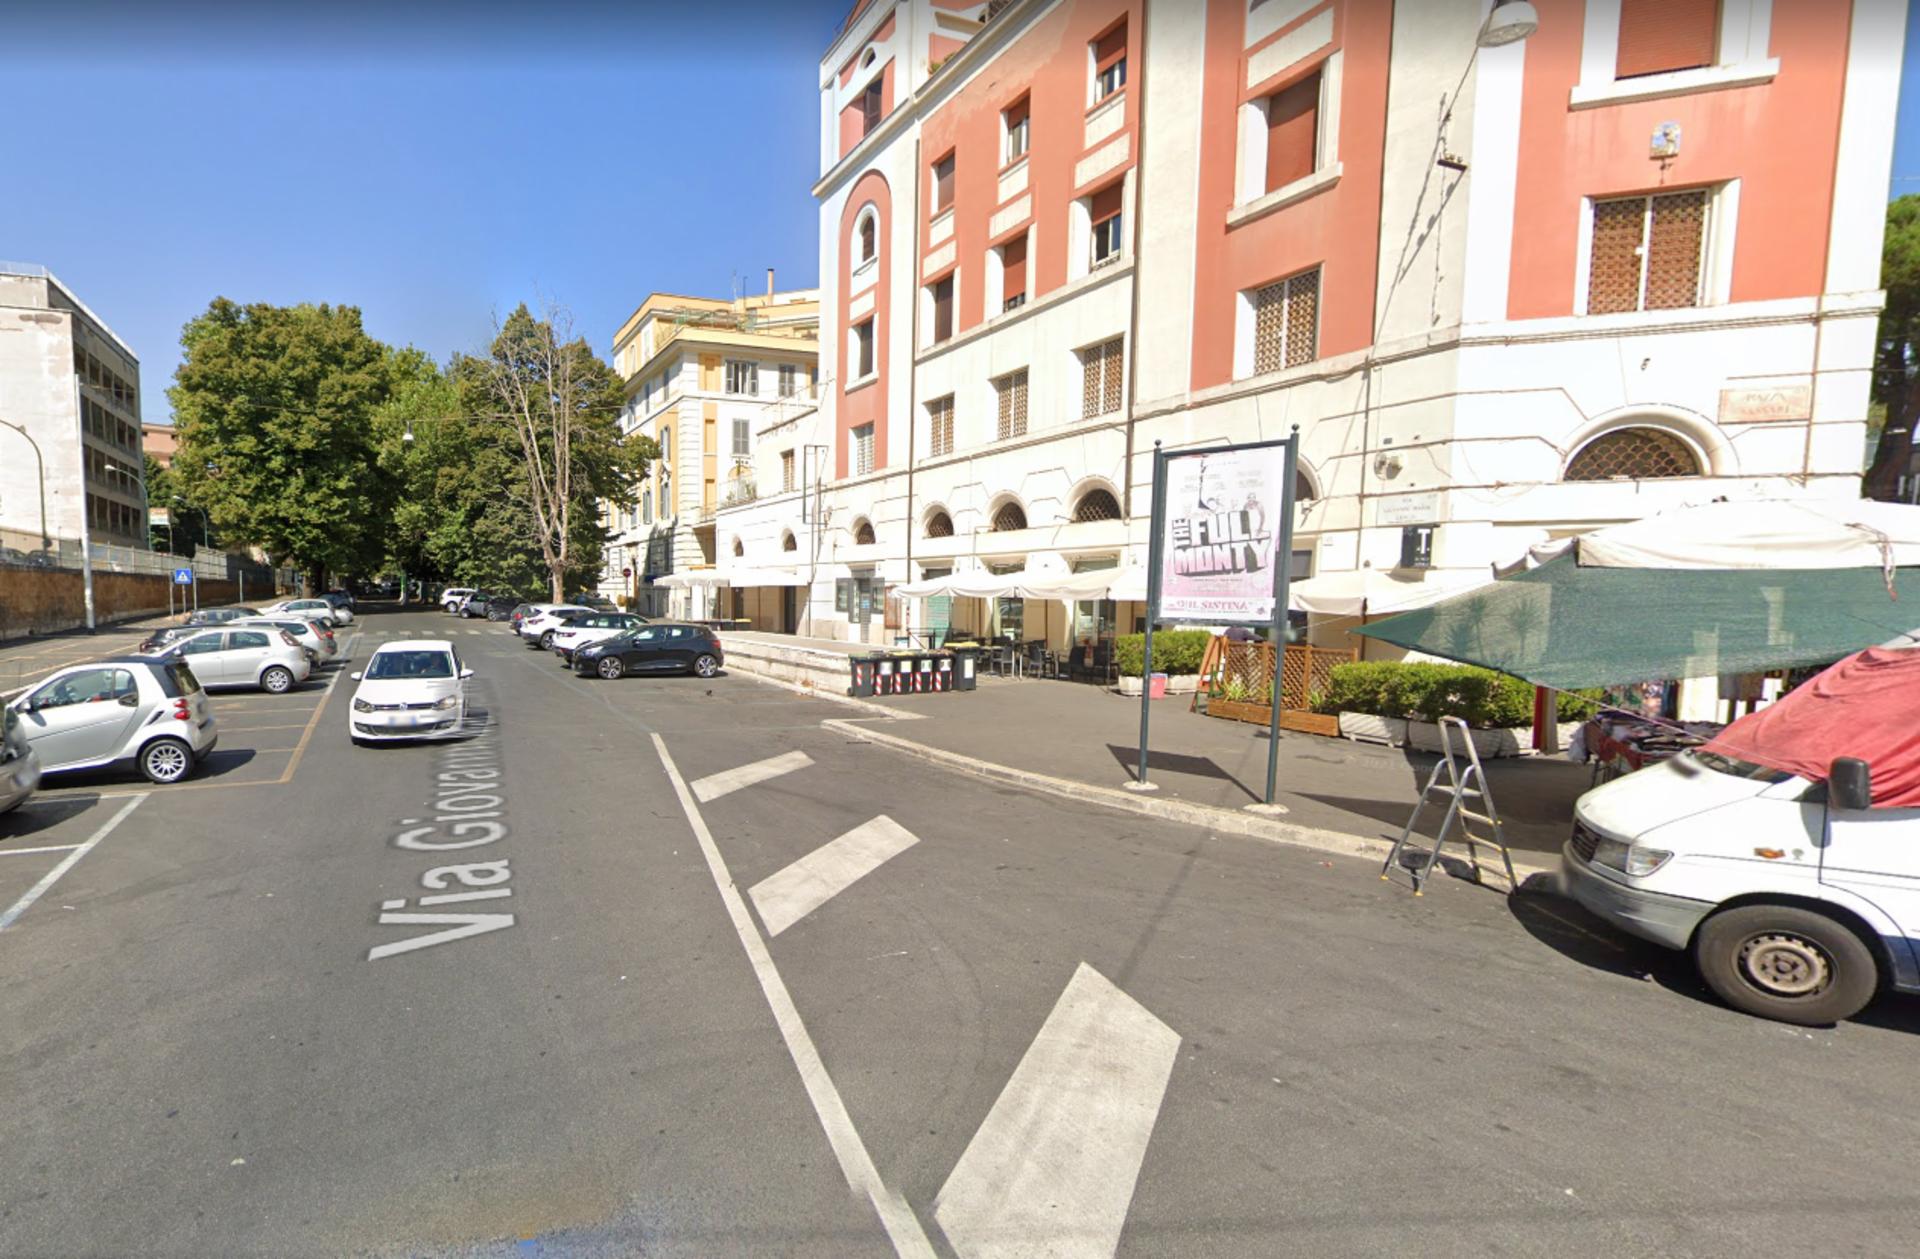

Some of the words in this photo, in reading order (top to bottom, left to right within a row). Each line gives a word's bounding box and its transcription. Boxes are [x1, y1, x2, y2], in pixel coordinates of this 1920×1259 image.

[1172, 518, 1191, 549] THE
[1189, 510, 1271, 547] FULL
[1173, 536, 1272, 576] MONTY
[1201, 600, 1249, 611] SISTINA
